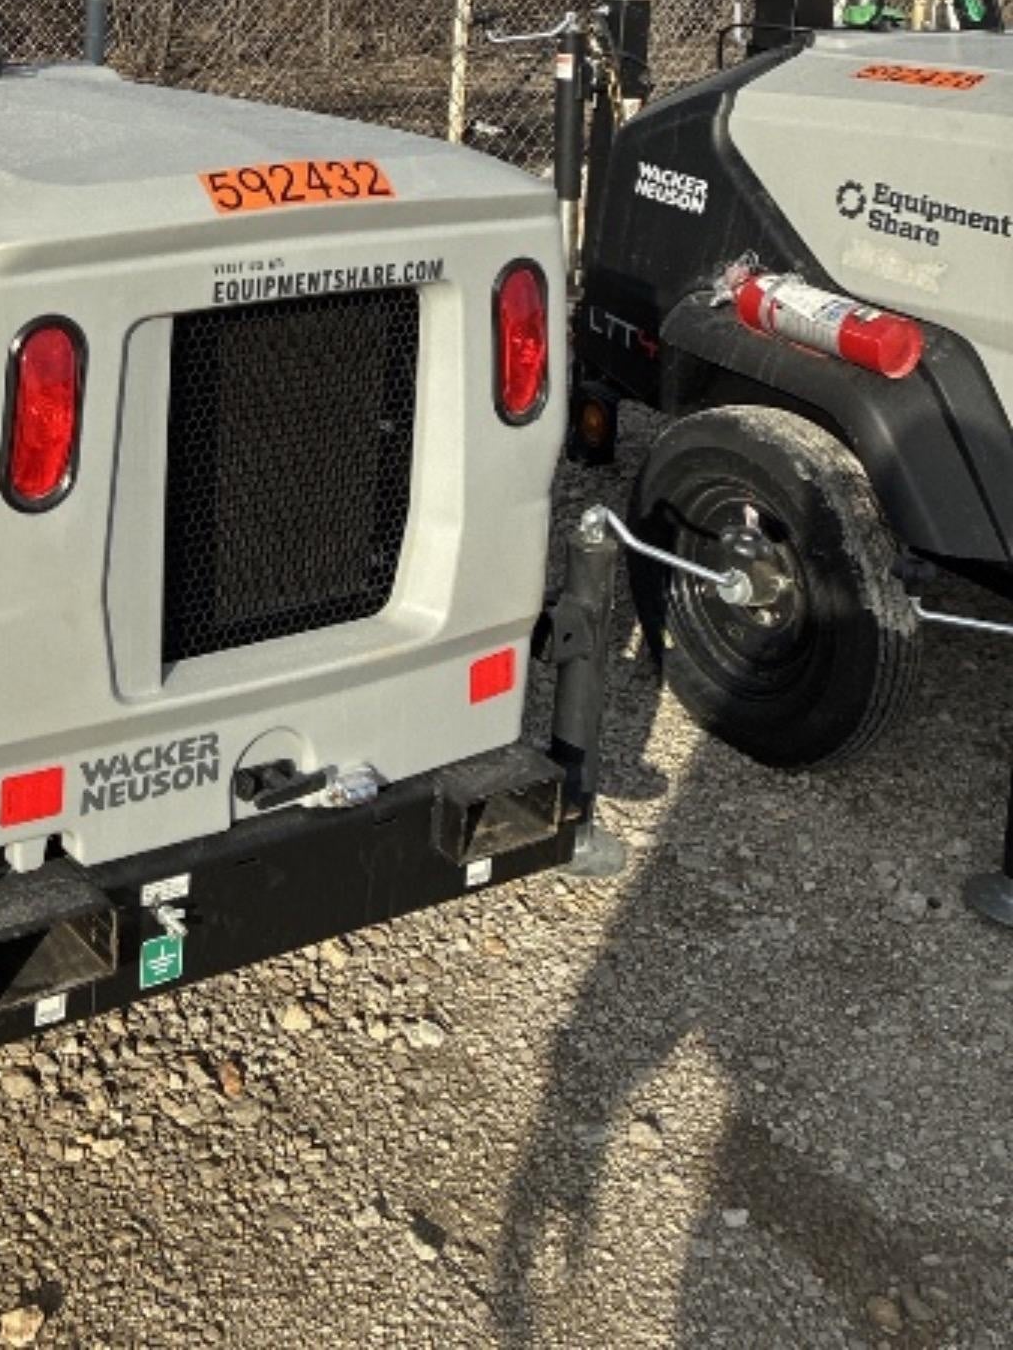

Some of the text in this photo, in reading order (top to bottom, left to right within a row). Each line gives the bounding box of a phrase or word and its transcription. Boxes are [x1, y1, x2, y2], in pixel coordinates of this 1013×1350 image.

[207, 160, 392, 211] 592432
[634, 179, 707, 215] NEUSON
[637, 160, 708, 197] WACKER
[867, 208, 940, 247] Share
[871, 181, 1013, 238] Equipment
[213, 258, 444, 304] EQUIPMENTSHARE.COM
[79, 731, 219, 786] WACKER
[79, 758, 219, 817] NEUSON
